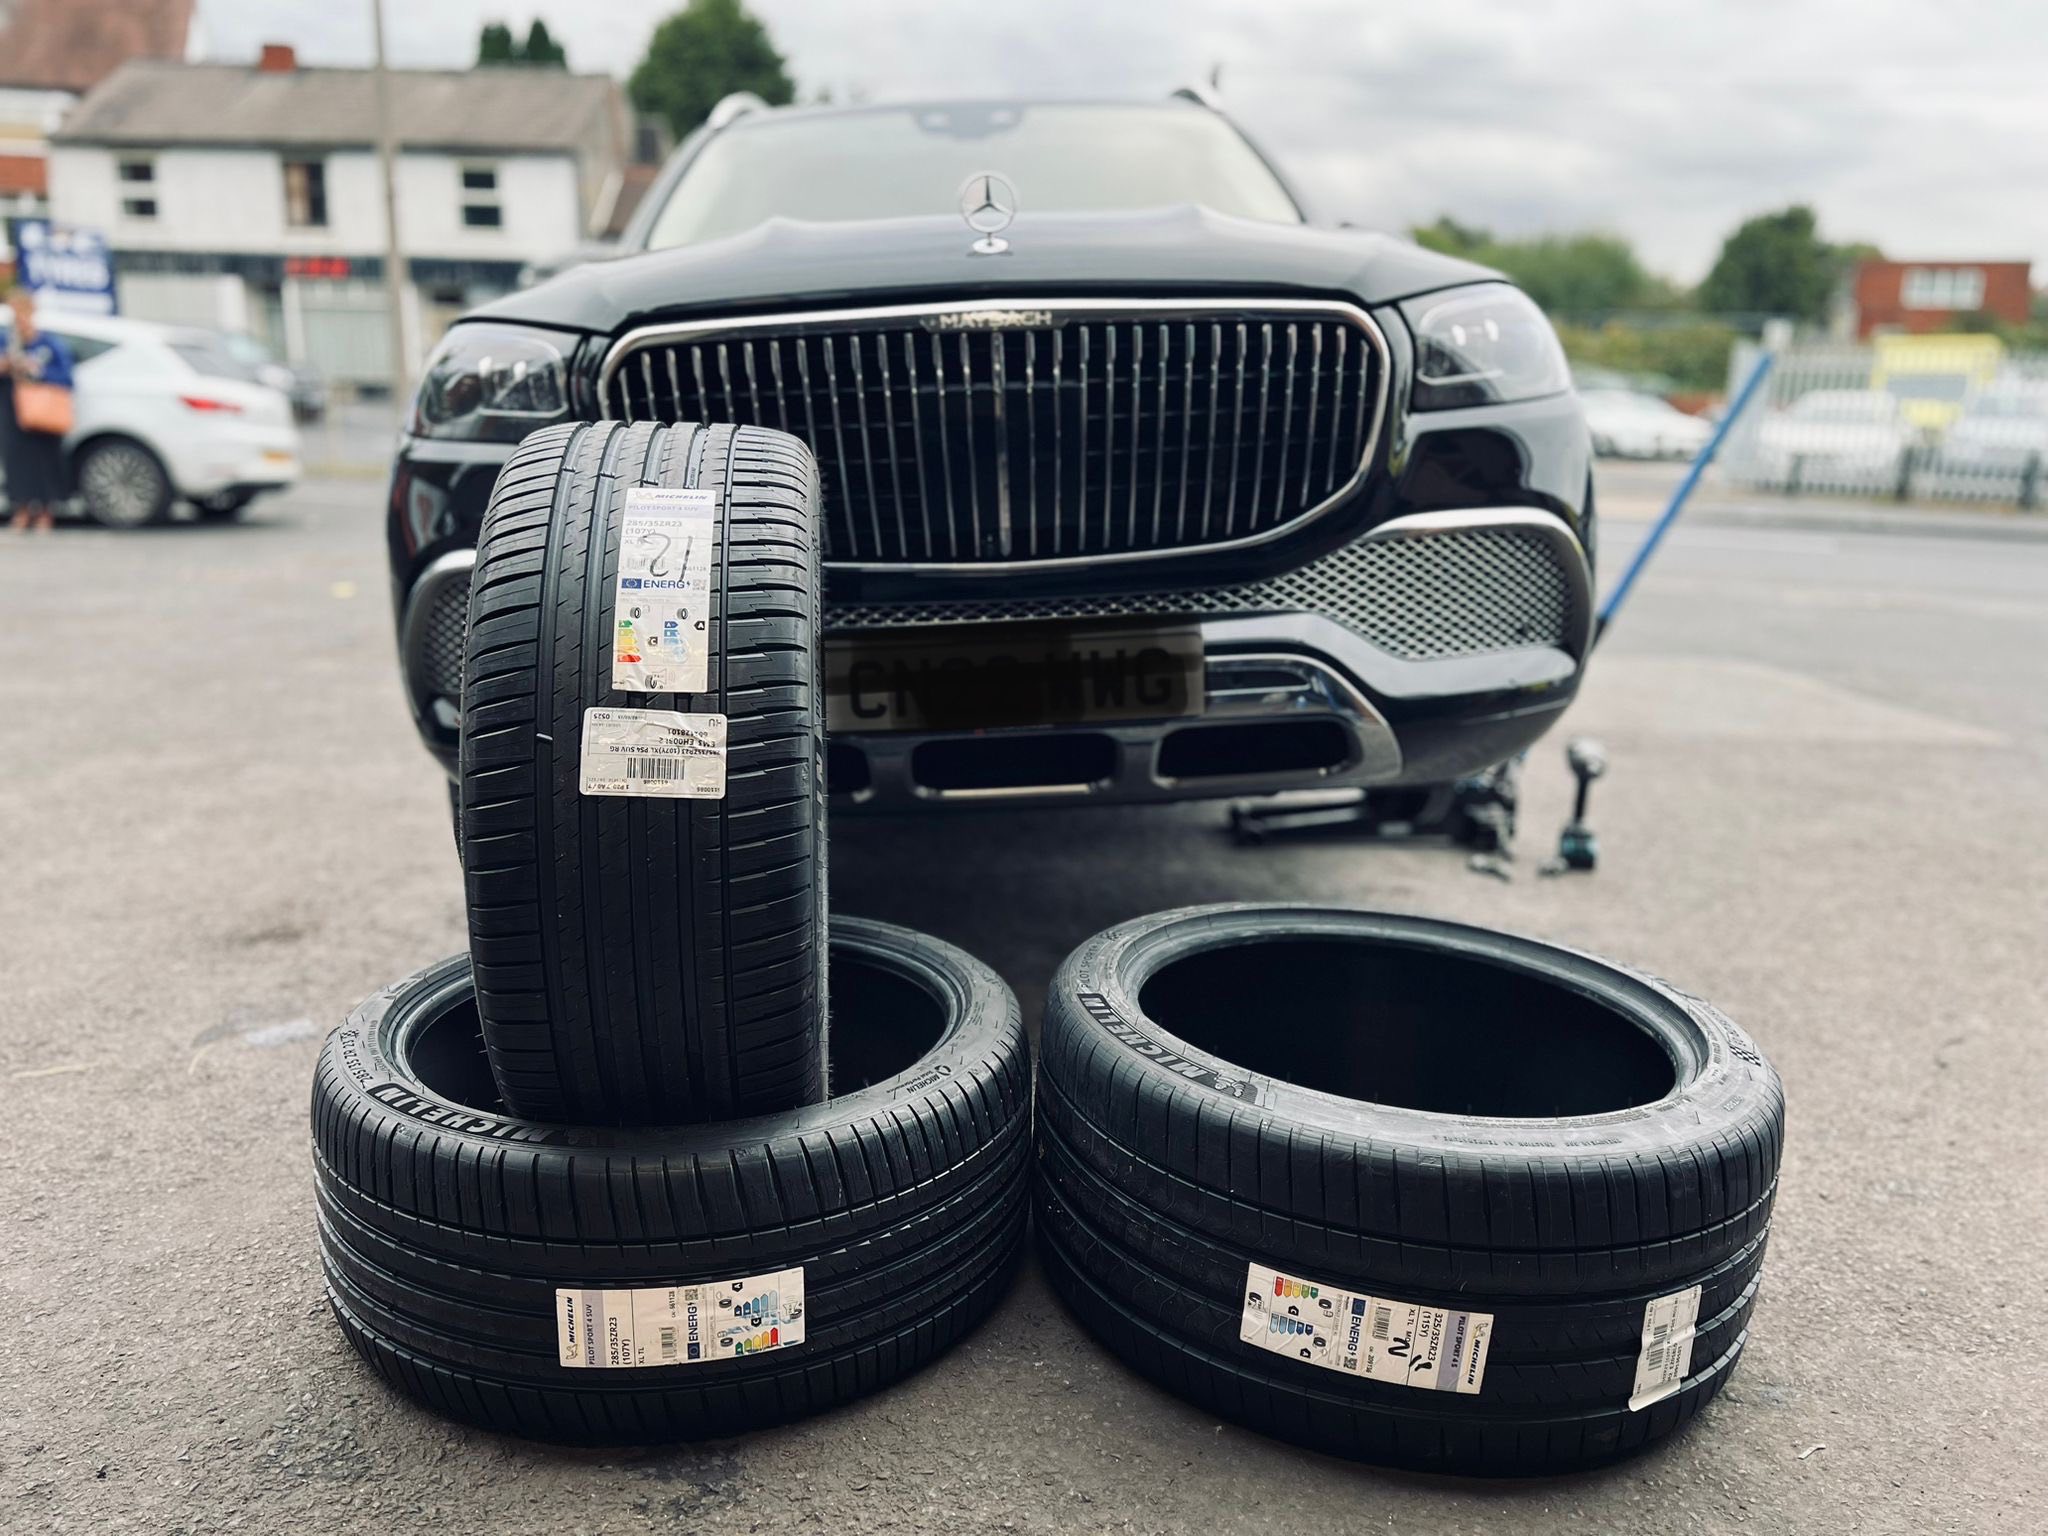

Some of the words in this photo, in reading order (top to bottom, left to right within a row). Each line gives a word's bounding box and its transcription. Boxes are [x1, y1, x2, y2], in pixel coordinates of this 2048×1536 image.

[938, 310, 1053, 329] MAYBACH
[644, 580, 685, 589] ENERG
[1079, 993, 1207, 1079] MICHELIN
[347, 1059, 374, 1083] 285/35
[907, 1073, 941, 1094] MICHELIN
[373, 1086, 553, 1142] MICHELIN
[566, 1296, 576, 1344] MICHELIN
[585, 1304, 593, 1317] SUV
[1408, 1308, 1415, 1317] XL
[687, 1306, 699, 1341] ENERG
[1407, 1318, 1415, 1326] TL
[1418, 1310, 1432, 1338] (115Y)
[1457, 1315, 1466, 1336] PILOT
[586, 1324, 594, 1345] SPORT
[609, 1316, 619, 1365] 285/35ZR23
[1347, 1316, 1362, 1352] ENERG
[1428, 1312, 1443, 1361] 325/35ZR23
[587, 1346, 595, 1365] PILOT
[621, 1338, 632, 1365] (107Y)
[638, 1347, 645, 1355] TL
[1453, 1336, 1463, 1358] SPORT
[638, 1355, 645, 1364] XL
[1467, 1339, 1481, 1386] MICHELIN
